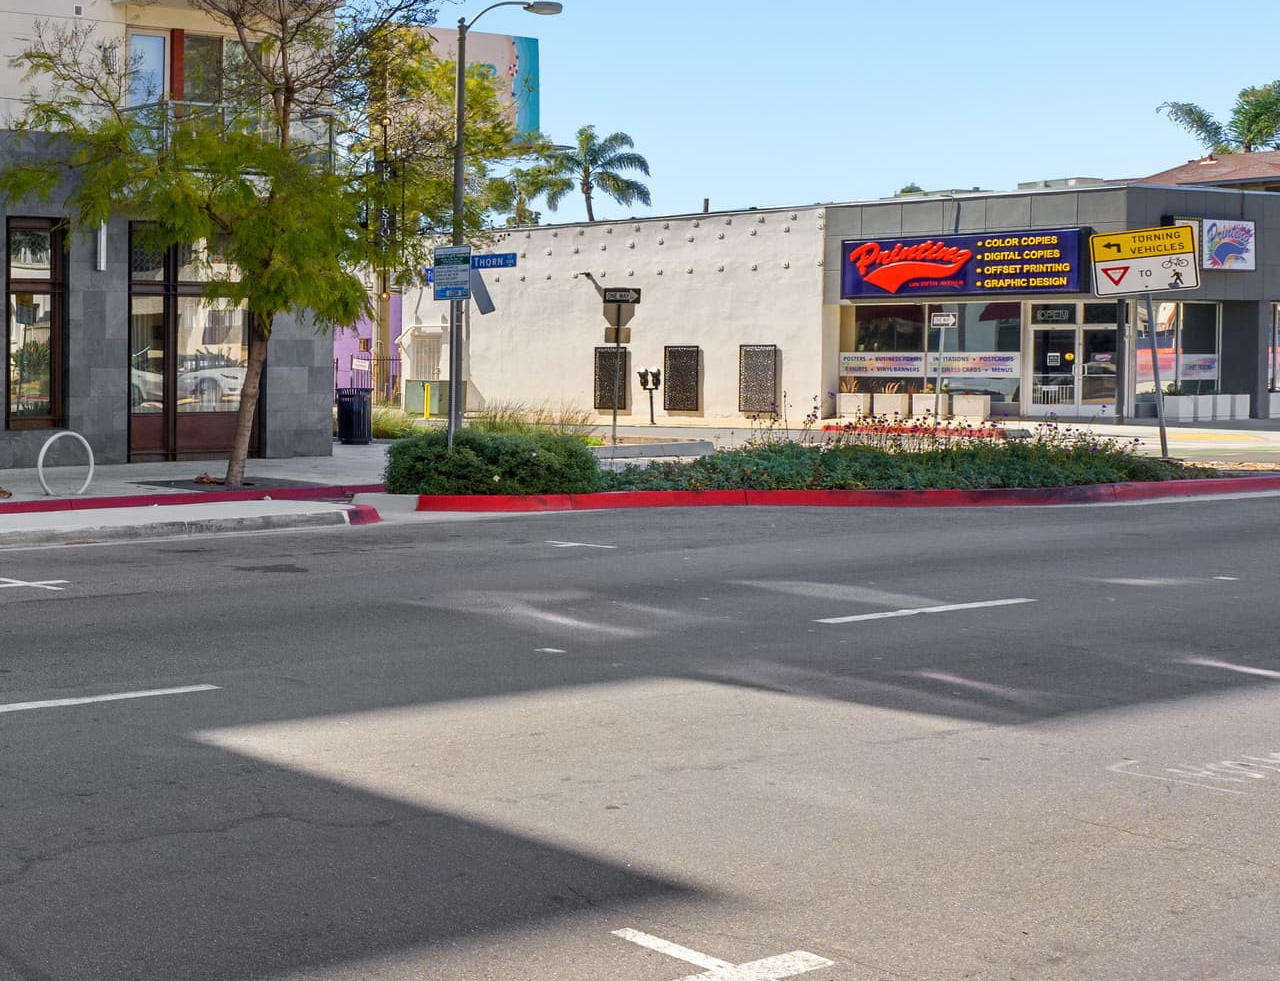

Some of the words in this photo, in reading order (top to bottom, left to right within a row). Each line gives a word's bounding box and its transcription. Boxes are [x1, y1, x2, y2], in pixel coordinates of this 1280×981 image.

[985, 238, 1019, 247] COLOR
[1021, 236, 1058, 245] COPIES
[1132, 232, 1181, 243] TURNING
[1130, 242, 1185, 254] VEHICLES
[850, 241, 972, 275] Printing
[984, 252, 1021, 261] DIGITAL
[1023, 249, 1060, 259] COPIES
[474, 257, 504, 267] THORN
[984, 265, 1021, 274] OFFSET
[1023, 263, 1071, 273] PRINTING
[1138, 269, 1152, 277] TO
[984, 278, 1027, 288] GRAPHIC
[1029, 277, 1067, 286] DESIGN
[1038, 310, 1069, 320] OPEN
